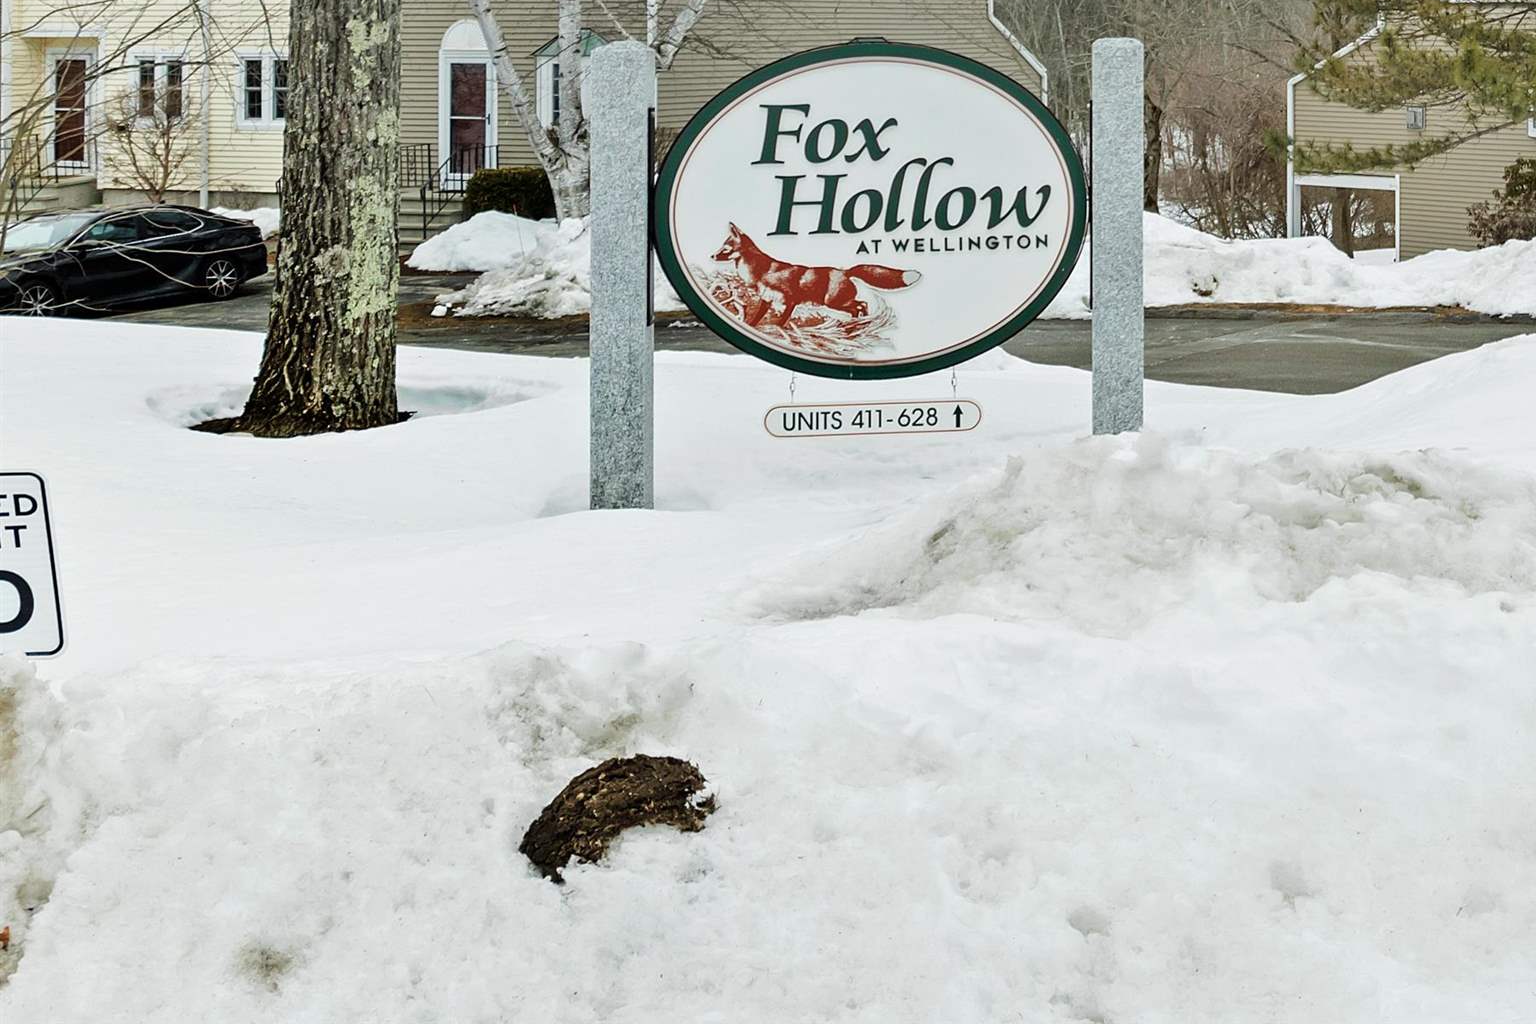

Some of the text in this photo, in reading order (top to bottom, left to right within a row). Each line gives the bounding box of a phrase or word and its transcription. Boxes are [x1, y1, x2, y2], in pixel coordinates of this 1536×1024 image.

[751, 103, 898, 166] Fox
[766, 157, 1052, 236] Hollow
[856, 234, 1049, 254] AT WELLINGTON
[782, 407, 939, 432] UNITS 411-628
